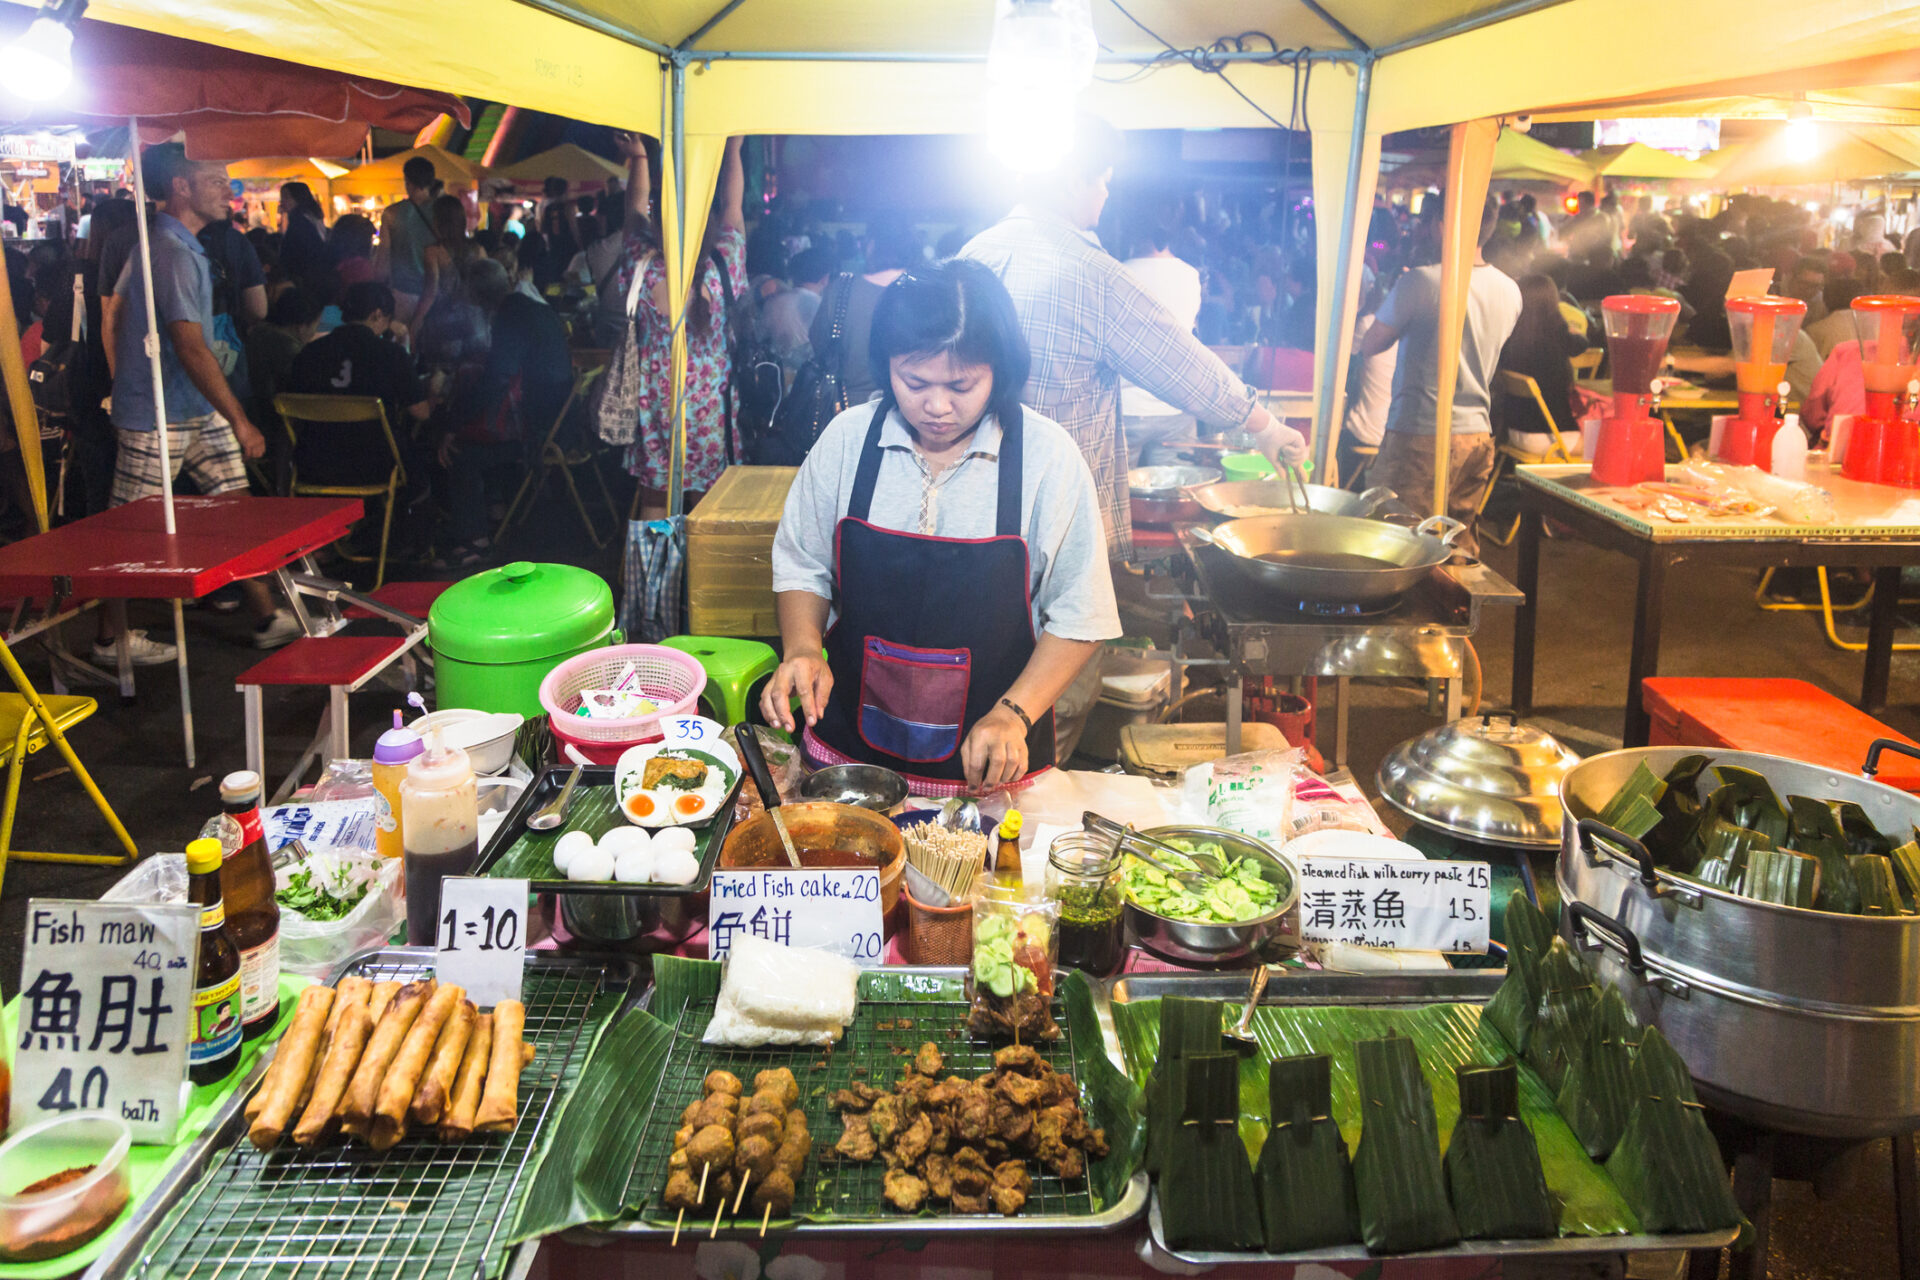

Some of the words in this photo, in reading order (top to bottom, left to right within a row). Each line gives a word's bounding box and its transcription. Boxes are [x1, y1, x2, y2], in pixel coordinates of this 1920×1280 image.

[676, 719, 704, 741] 35
[712, 875, 757, 898] Fried
[852, 874, 879, 902] 20
[1302, 863, 1346, 879] steamed
[1374, 863, 1398, 879] with
[1400, 870, 1430, 885] curry
[1434, 866, 1463, 884] paste
[1303, 888, 1406, 930] 清蒸魚
[31, 909, 85, 945] Fish
[100, 920, 156, 945] maw
[851, 932, 882, 959] 20
[20, 968, 172, 1056] 魚肚
[38, 1065, 109, 1112] 40
